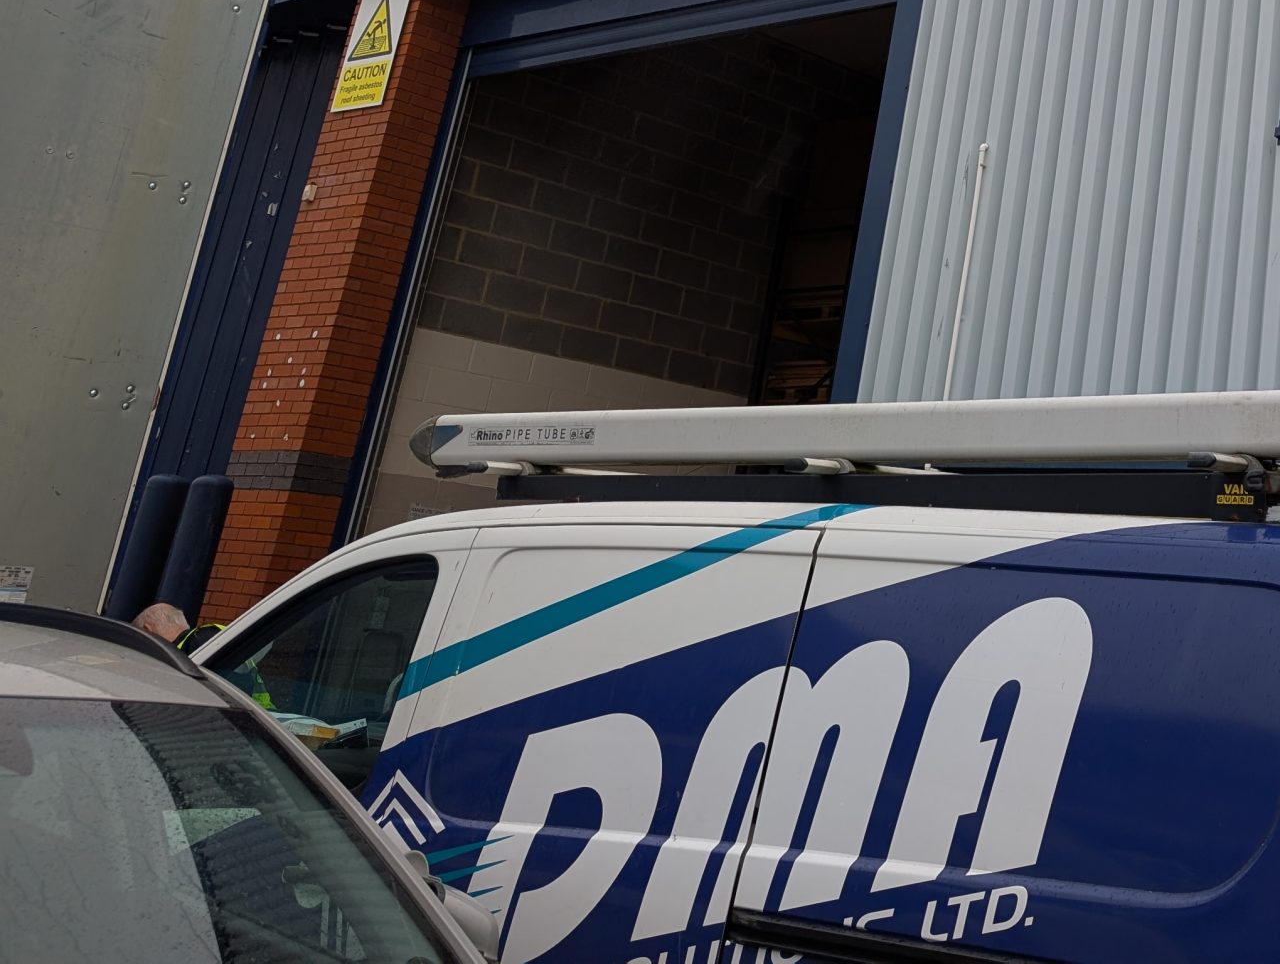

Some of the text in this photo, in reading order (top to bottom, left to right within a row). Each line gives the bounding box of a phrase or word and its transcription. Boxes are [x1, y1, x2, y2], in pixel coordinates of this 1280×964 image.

[344, 63, 387, 82] CAUTION
[340, 81, 383, 93] Fragile asbestos
[476, 430, 503, 441] Rhino
[505, 428, 531, 440] PIPE
[538, 428, 567, 440] TUBE
[1217, 496, 1254, 504] GUARD
[466, 597, 1093, 964] DMA
[920, 885, 1036, 941] LTD.
